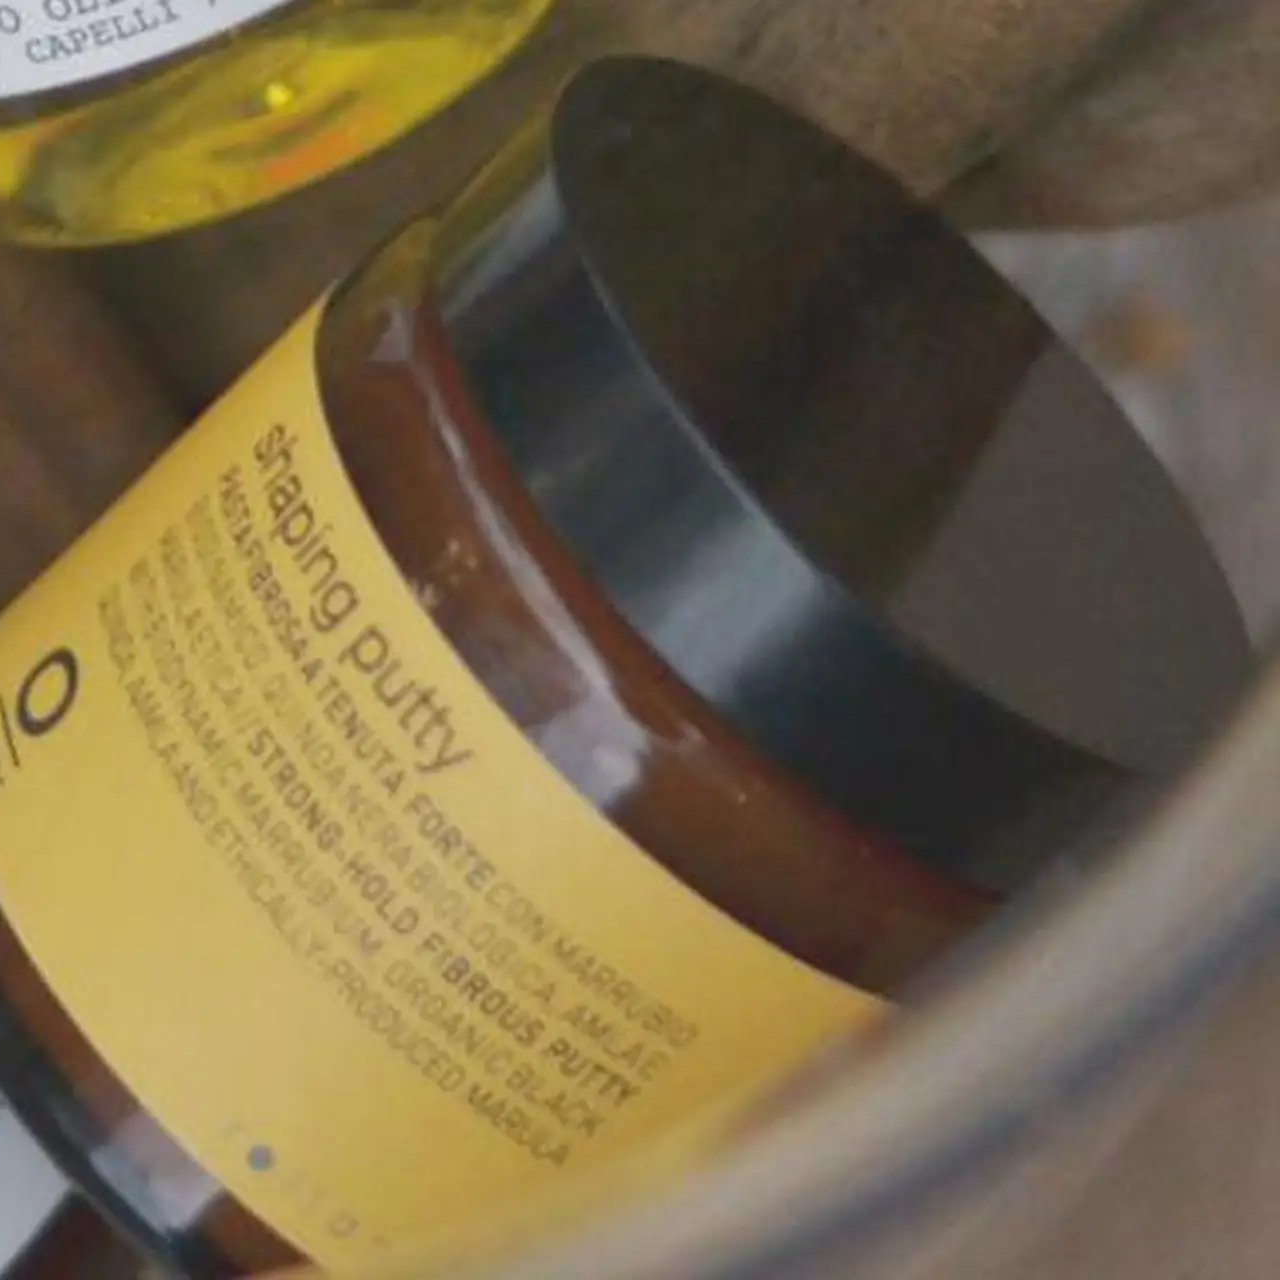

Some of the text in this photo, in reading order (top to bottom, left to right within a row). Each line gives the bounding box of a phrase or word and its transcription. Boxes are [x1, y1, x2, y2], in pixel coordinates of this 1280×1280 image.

[16, 646, 79, 738] O
[254, 423, 475, 774] shaping putty
[247, 726, 419, 935] STRONG-HOLD
[415, 931, 547, 1046] FIBROUS
[542, 1037, 642, 1107] PUTTY
[314, 676, 406, 798] TENUTA
[402, 793, 497, 893] FORTE
